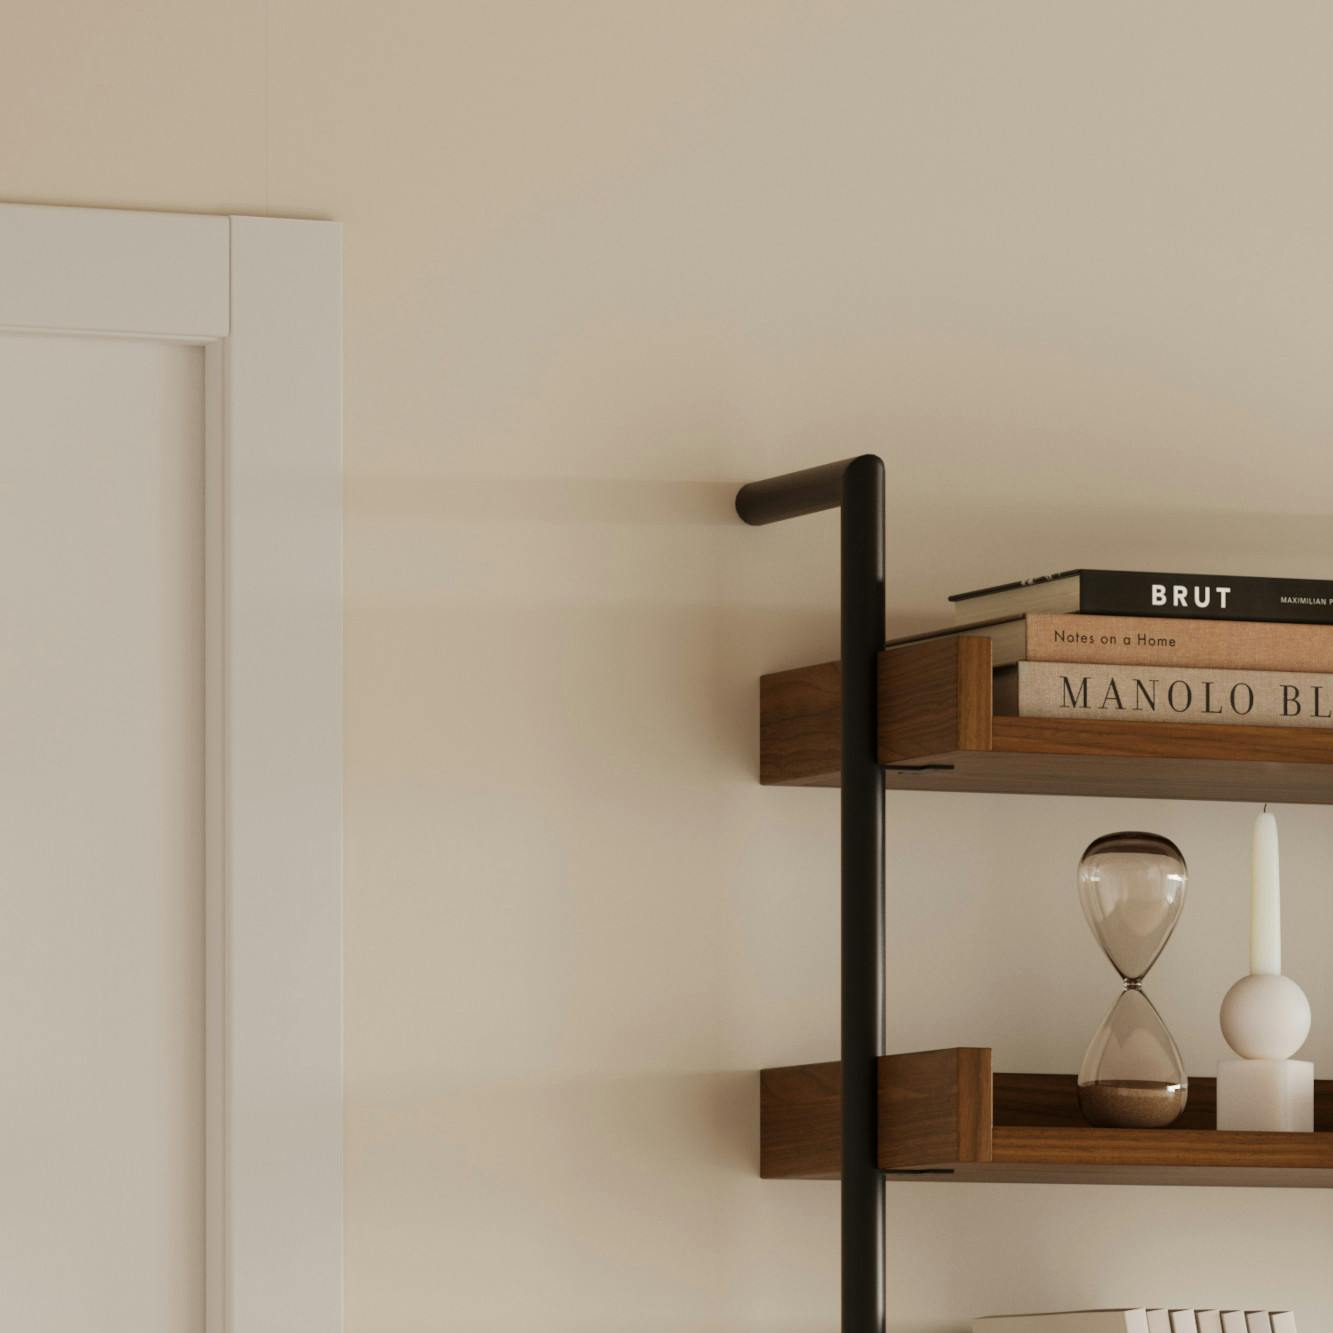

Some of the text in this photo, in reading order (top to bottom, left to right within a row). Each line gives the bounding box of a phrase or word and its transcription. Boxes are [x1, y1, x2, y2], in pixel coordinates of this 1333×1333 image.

[1151, 583, 1232, 609] BRUT
[1280, 596, 1327, 606] MAXIMILIAN
[1054, 630, 1176, 647] Notes on a Home
[1059, 675, 1256, 716] MANOLO
